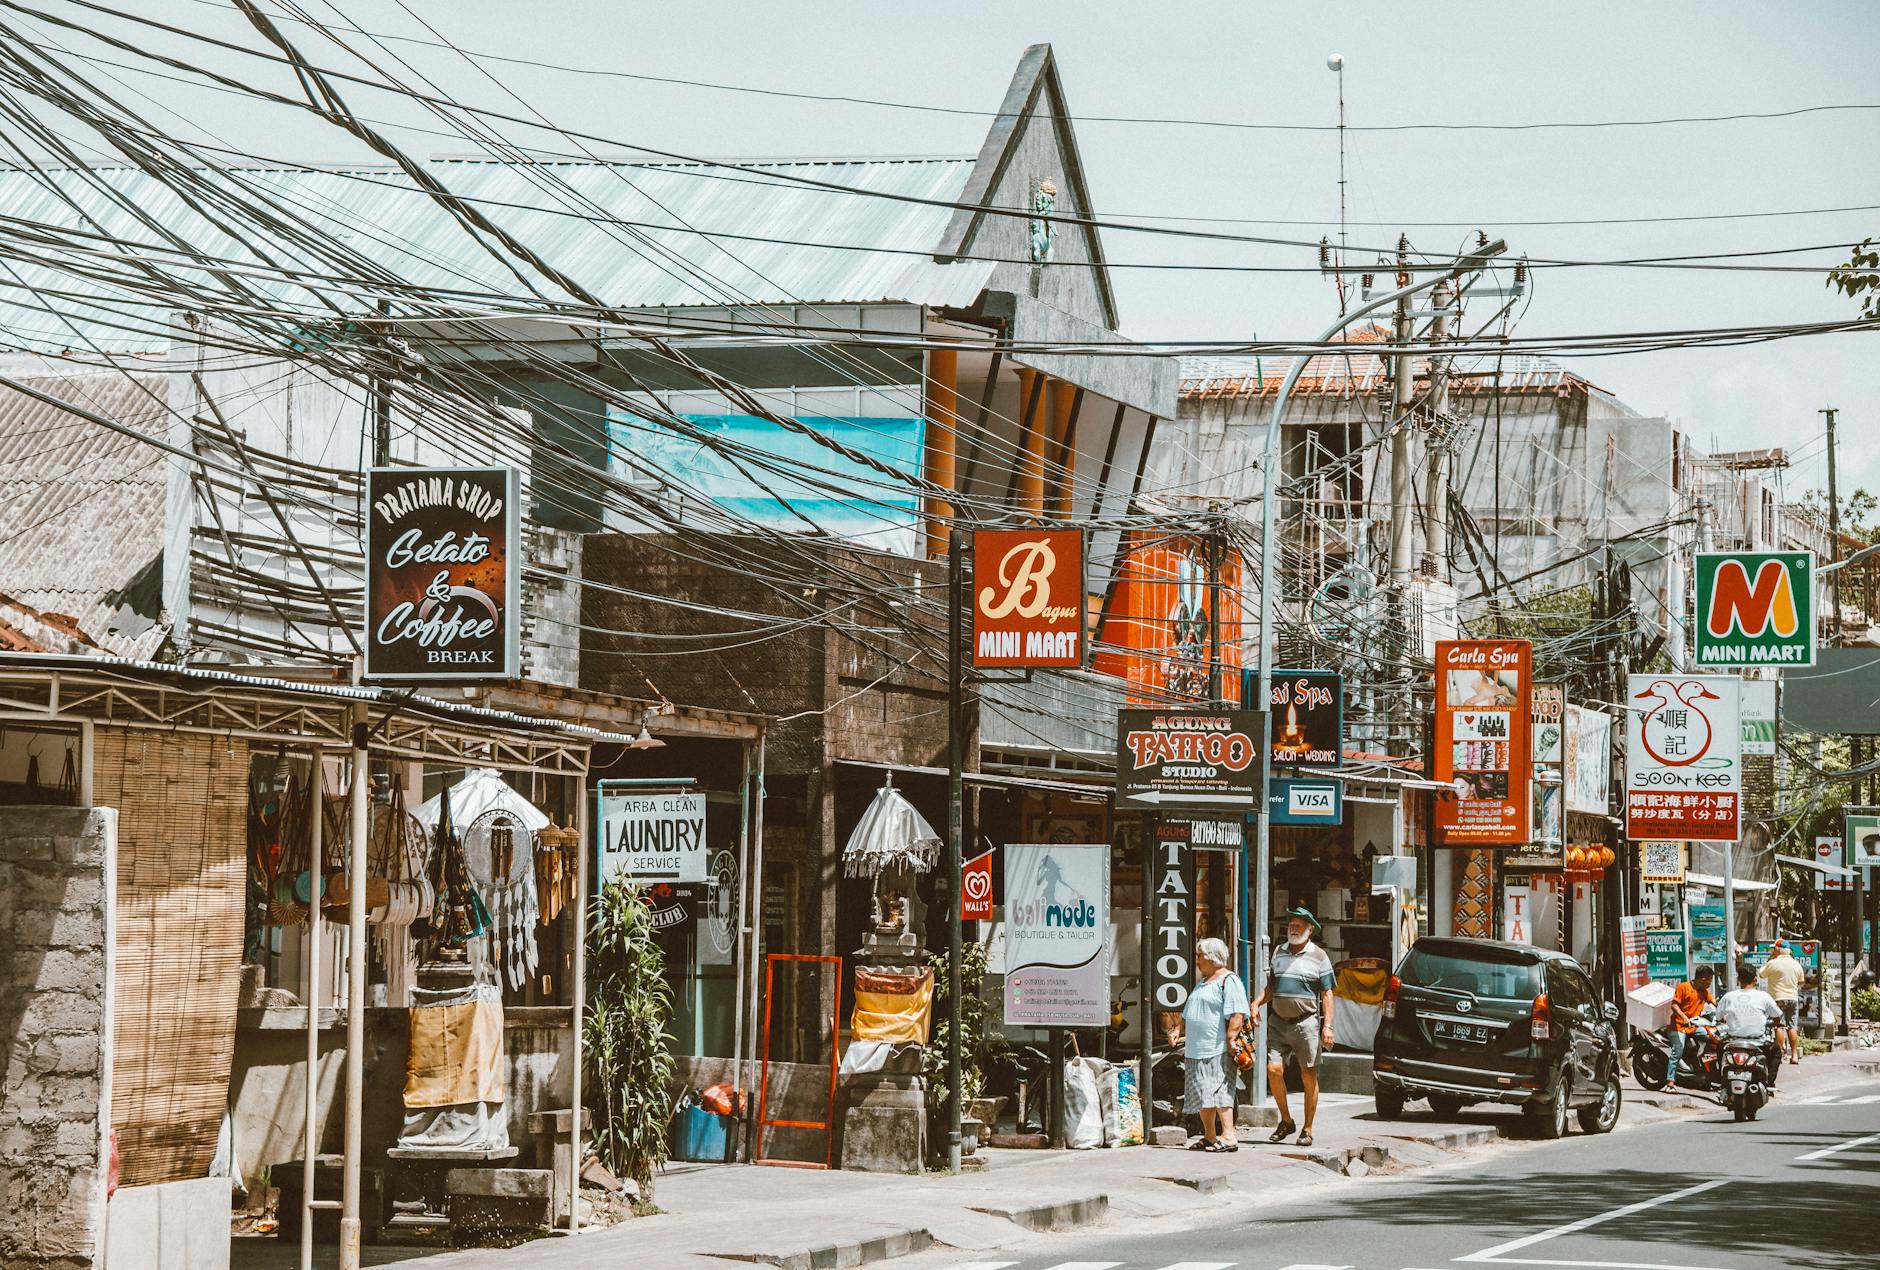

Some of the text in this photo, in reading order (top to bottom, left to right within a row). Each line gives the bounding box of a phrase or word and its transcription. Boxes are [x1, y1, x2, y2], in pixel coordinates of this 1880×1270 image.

[374, 477, 503, 524] PRATAMA SHOP
[386, 528, 490, 569] Gelato
[426, 570, 451, 602] &
[979, 538, 1078, 624] Bagus
[377, 602, 495, 648] Coffee
[978, 631, 1077, 658] MINI MART
[1702, 645, 1805, 662] MINI MART
[427, 650, 495, 663] BREAK
[1447, 647, 1519, 667] Carla Spa
[1271, 678, 1333, 711] ai Spa
[1151, 716, 1232, 731] AGUNG
[1126, 731, 1256, 772] TATTOO
[1273, 749, 1297, 761] SALON
[1305, 750, 1336, 762] WEDDING
[1161, 766, 1217, 779] STUDIO
[624, 800, 697, 813] ARBA CLEAN
[1269, 795, 1285, 803] refer
[1296, 794, 1329, 806] VISA
[605, 818, 704, 853] LAUNDRY
[1157, 826, 1190, 837] AGUNG
[1191, 820, 1241, 845] TATTOO STUDIO
[965, 900, 989, 912] WALL'S
[651, 907, 683, 927] CLUB
[1156, 841, 1189, 1008] TATTOO
[1014, 931, 1055, 939] BOUTIQUE
[1059, 931, 1064, 939] &
[1067, 931, 1095, 939] TAILOR
[1476, 1028, 1486, 1038] EZ
